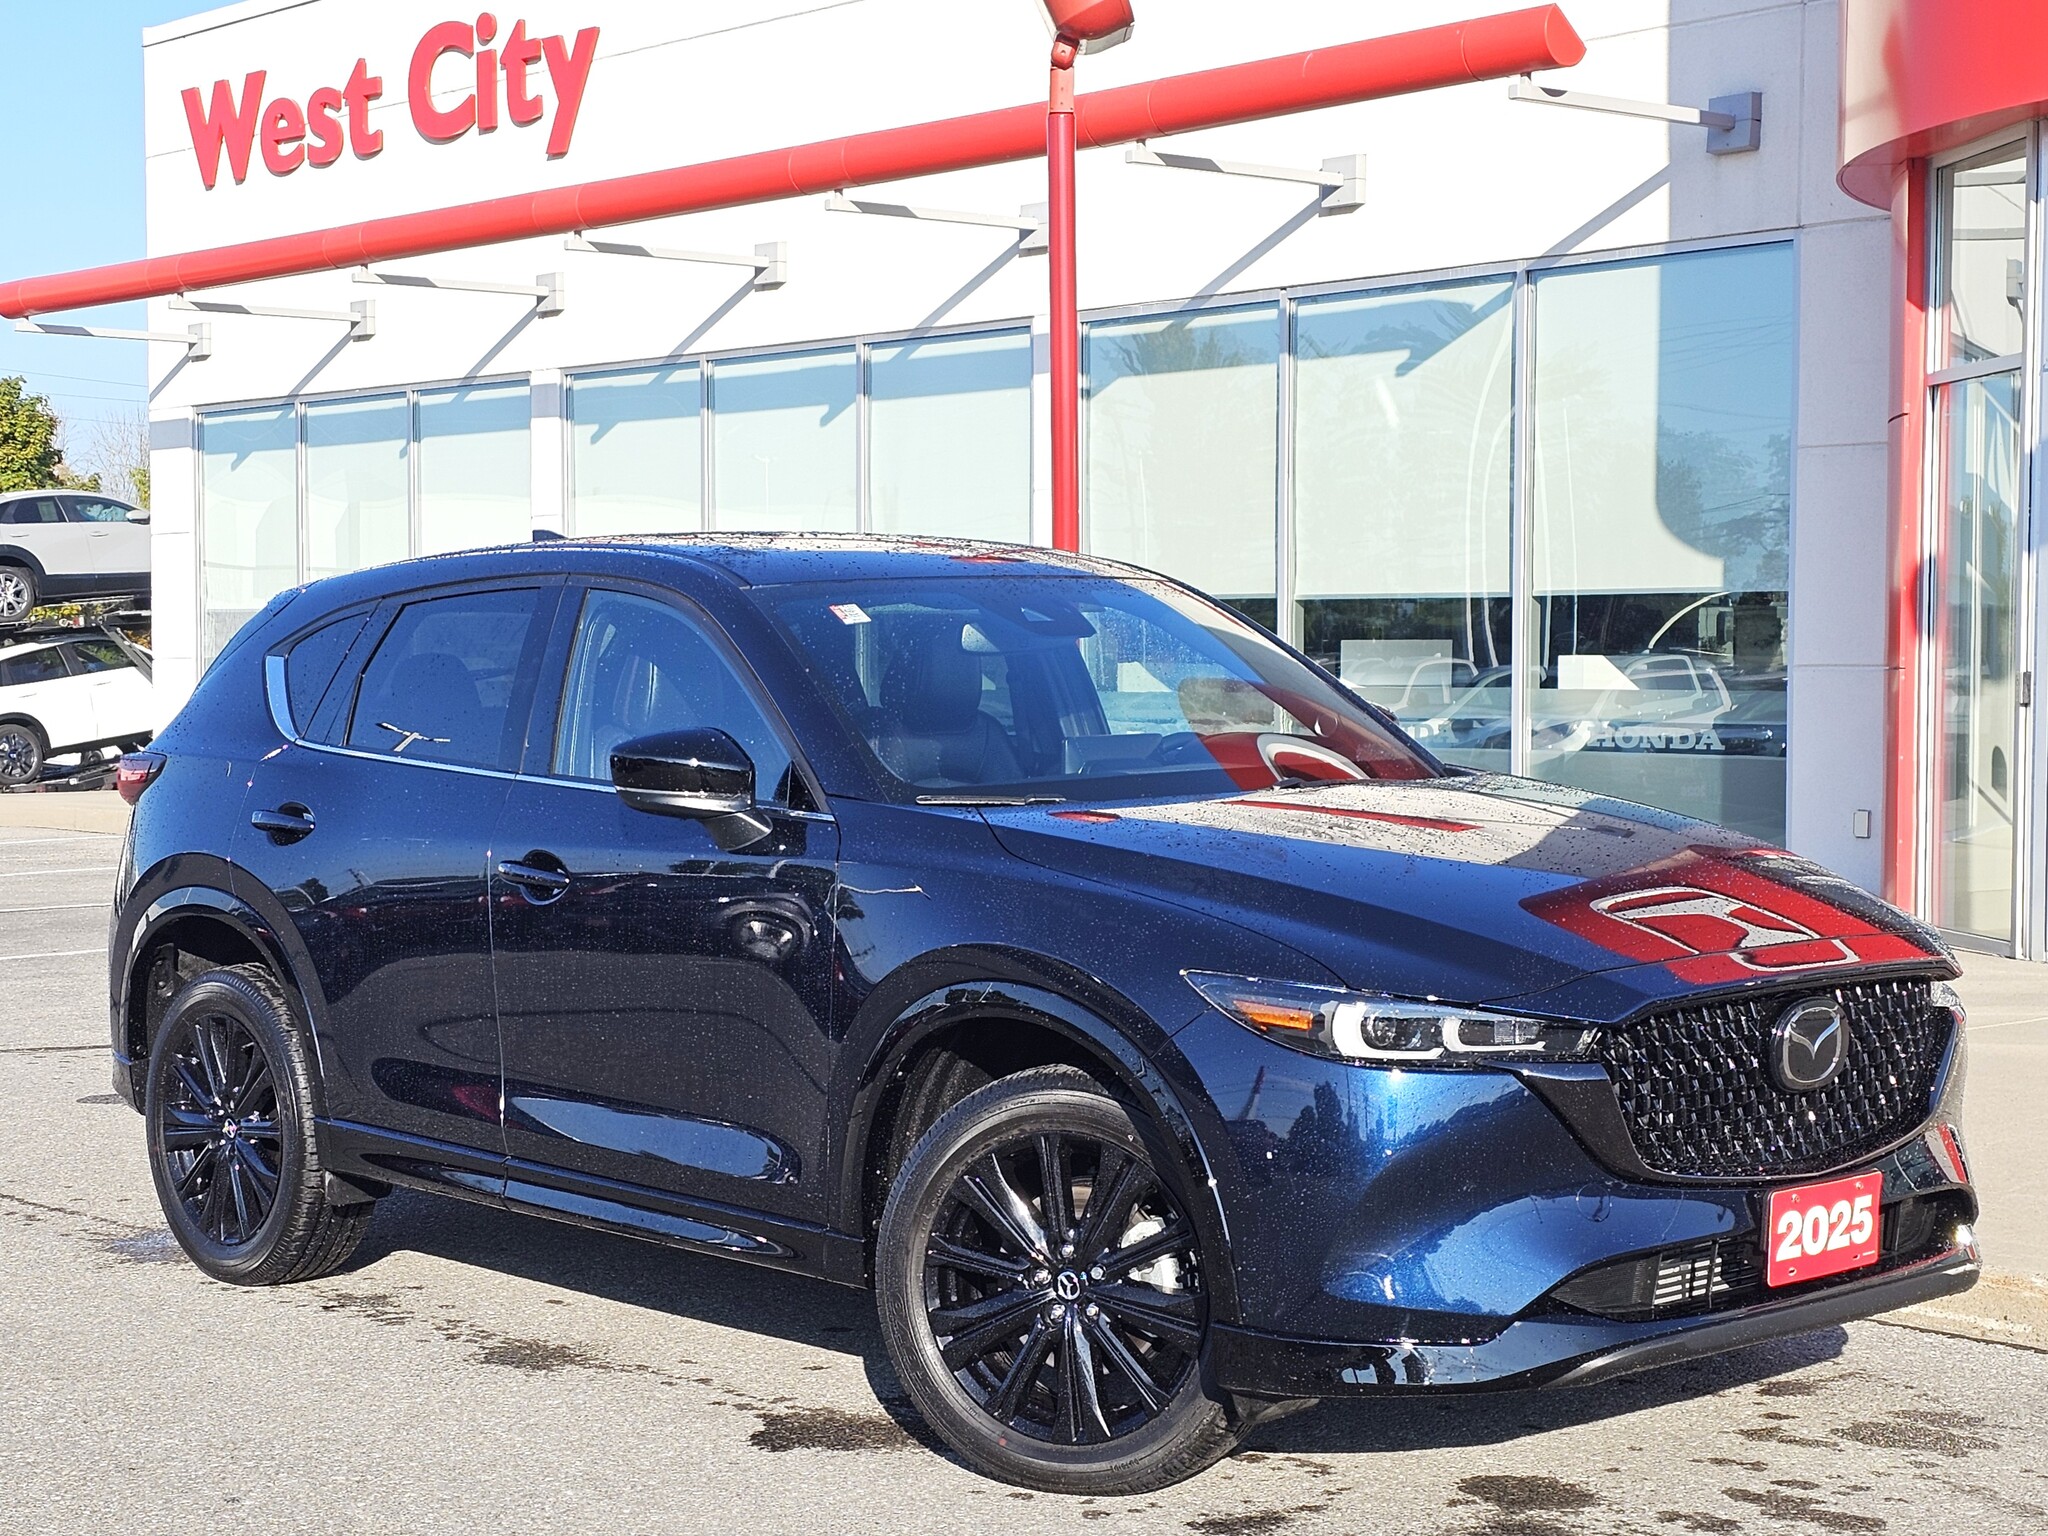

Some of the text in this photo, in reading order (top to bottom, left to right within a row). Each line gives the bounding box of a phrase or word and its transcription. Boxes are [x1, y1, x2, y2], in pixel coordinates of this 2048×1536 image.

[181, 12, 600, 191] West City
[1587, 721, 1726, 751] HONDA
[1776, 1194, 1873, 1262] 2025
